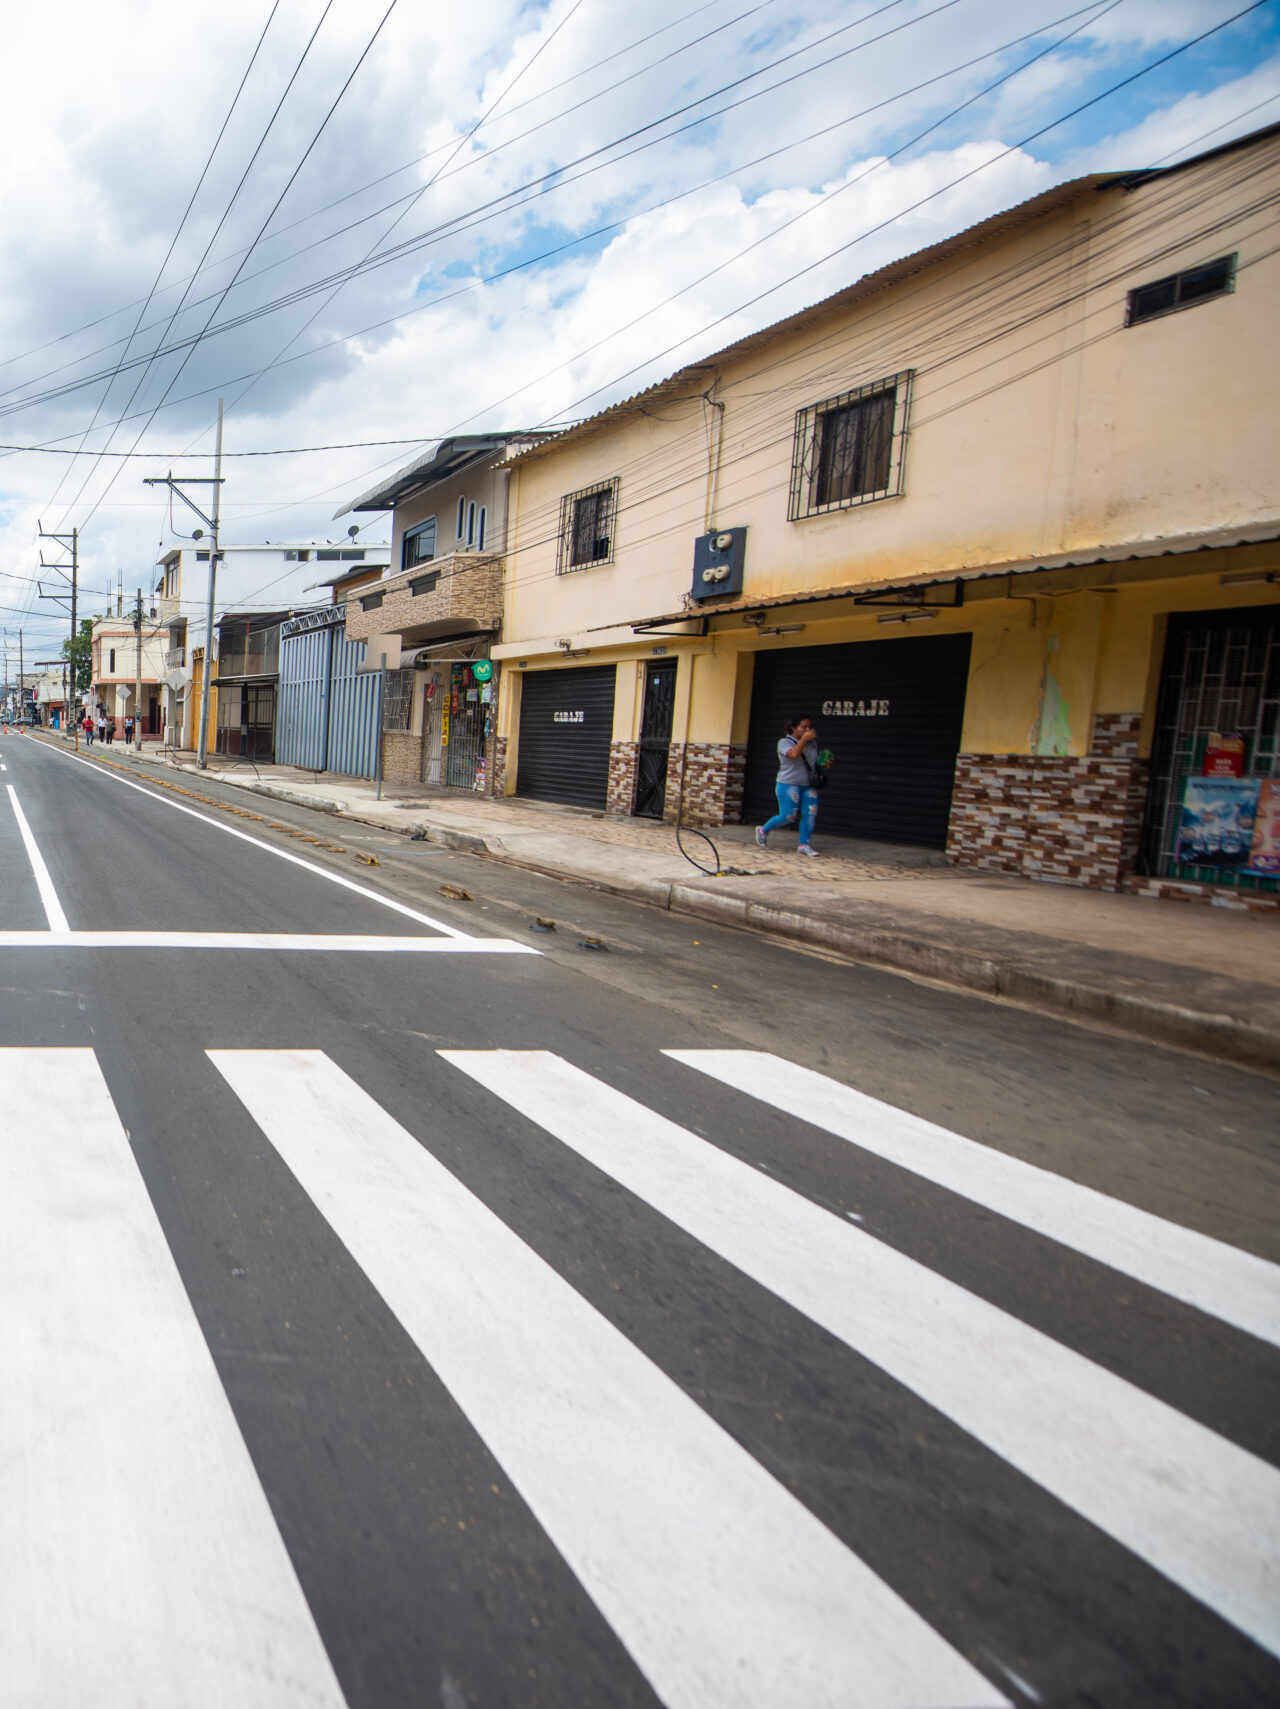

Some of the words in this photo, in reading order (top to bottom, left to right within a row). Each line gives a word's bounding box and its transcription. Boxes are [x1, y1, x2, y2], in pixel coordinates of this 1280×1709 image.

[822, 699, 889, 716] GARAJE
[440, 695, 450, 745] COPIAS
[553, 711, 585, 723] GARAJE
